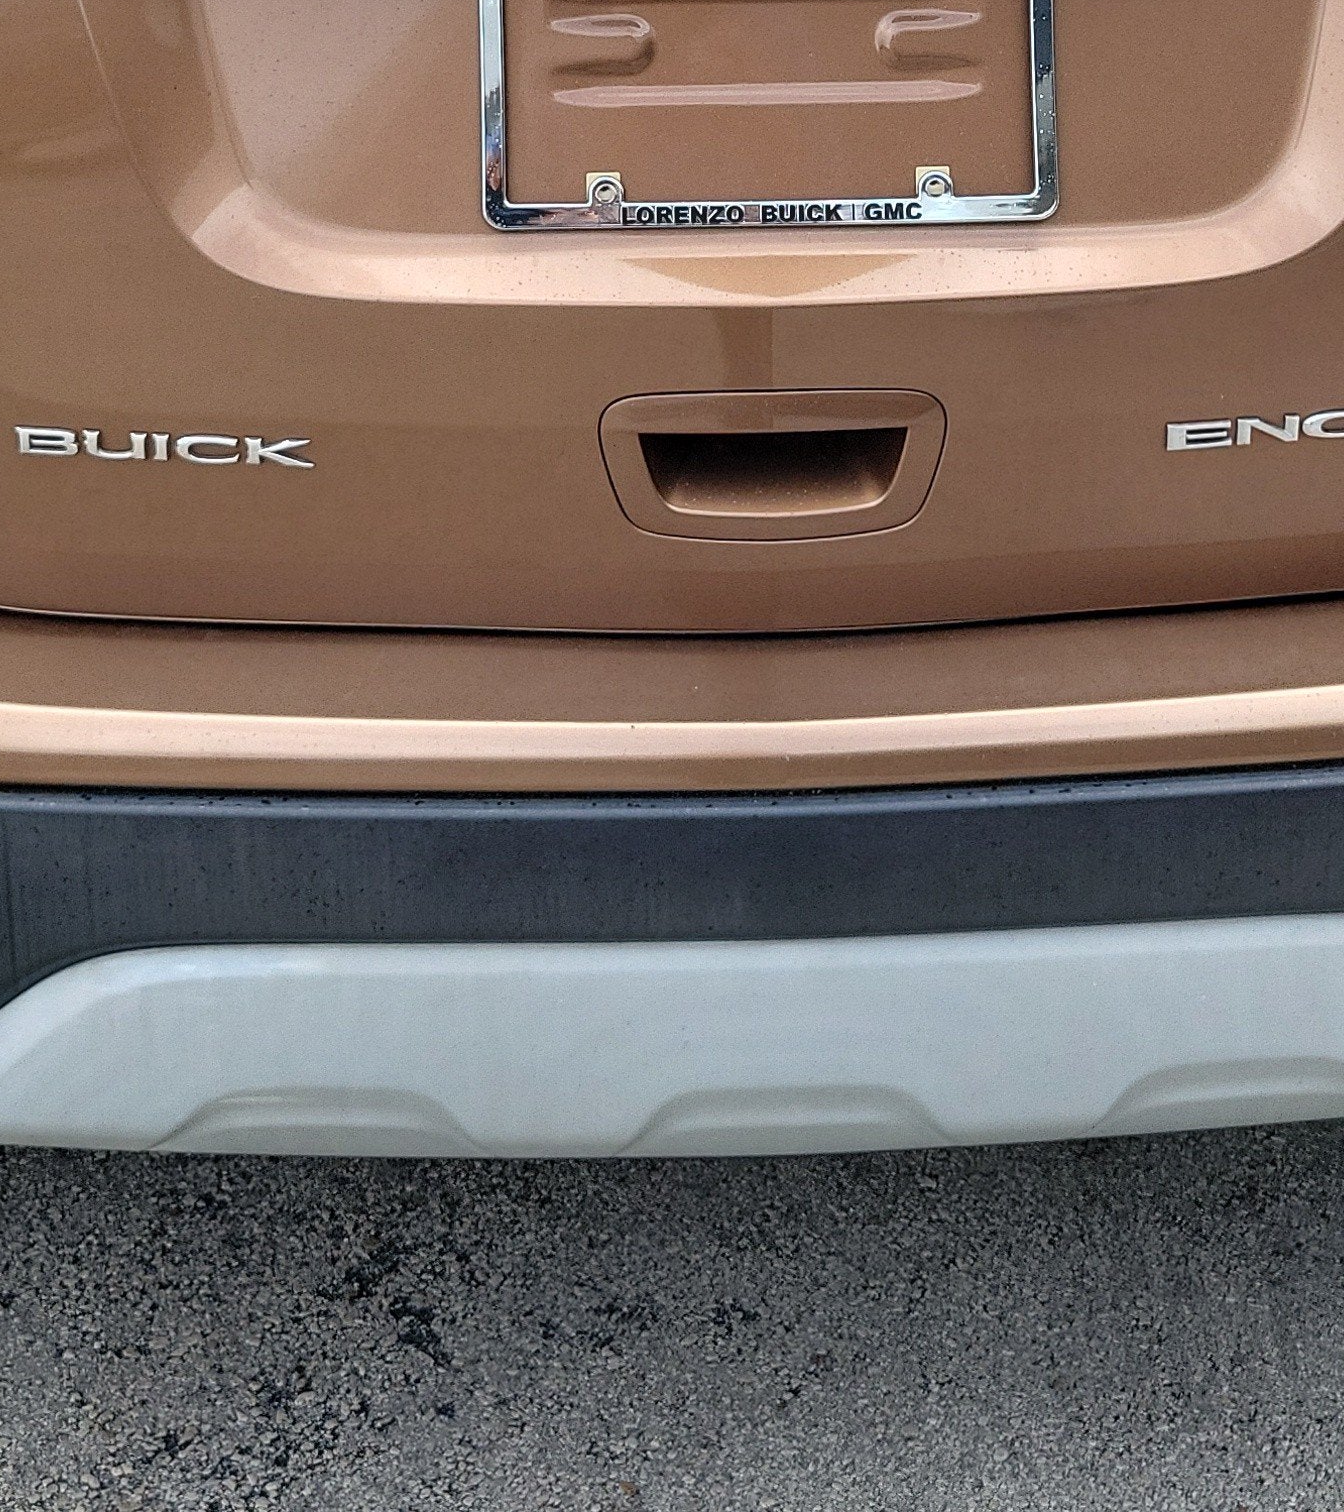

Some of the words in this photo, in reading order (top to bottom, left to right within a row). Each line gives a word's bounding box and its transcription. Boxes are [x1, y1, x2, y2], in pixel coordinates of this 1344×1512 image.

[622, 205, 744, 225] LORENZO
[760, 204, 843, 223] BUICK
[865, 202, 922, 221] GMC
[14, 426, 317, 469] BUICK
